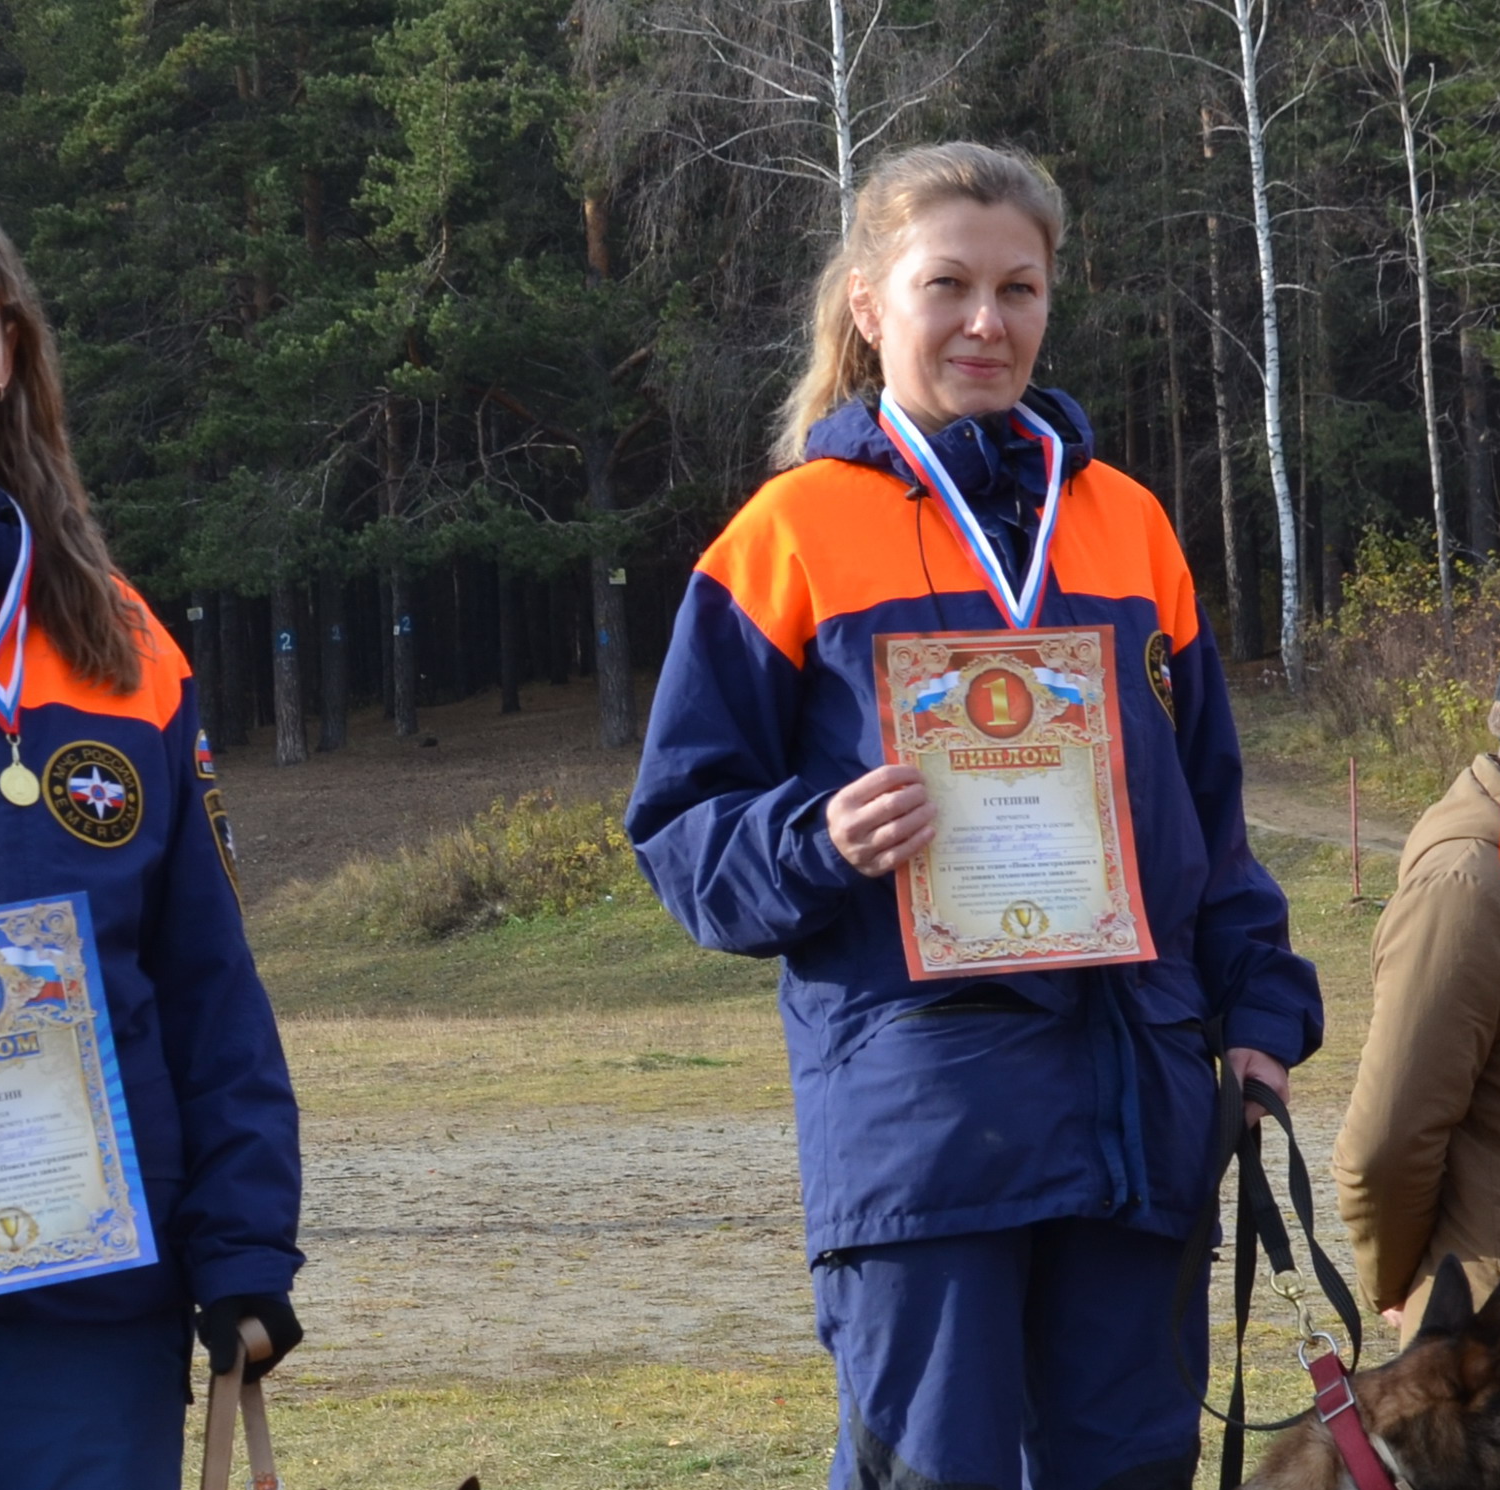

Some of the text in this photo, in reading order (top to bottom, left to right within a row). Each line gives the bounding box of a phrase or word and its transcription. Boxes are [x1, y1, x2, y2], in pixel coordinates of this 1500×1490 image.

[280, 632, 292, 650] 2
[982, 678, 1017, 726] 1
[52, 748, 135, 788] МЧС РОССИИ
[952, 748, 1060, 769] ДИПЛОМ
[989, 796, 1040, 807] СТЕПЕНИ
[55, 798, 135, 838] EMERCOM
